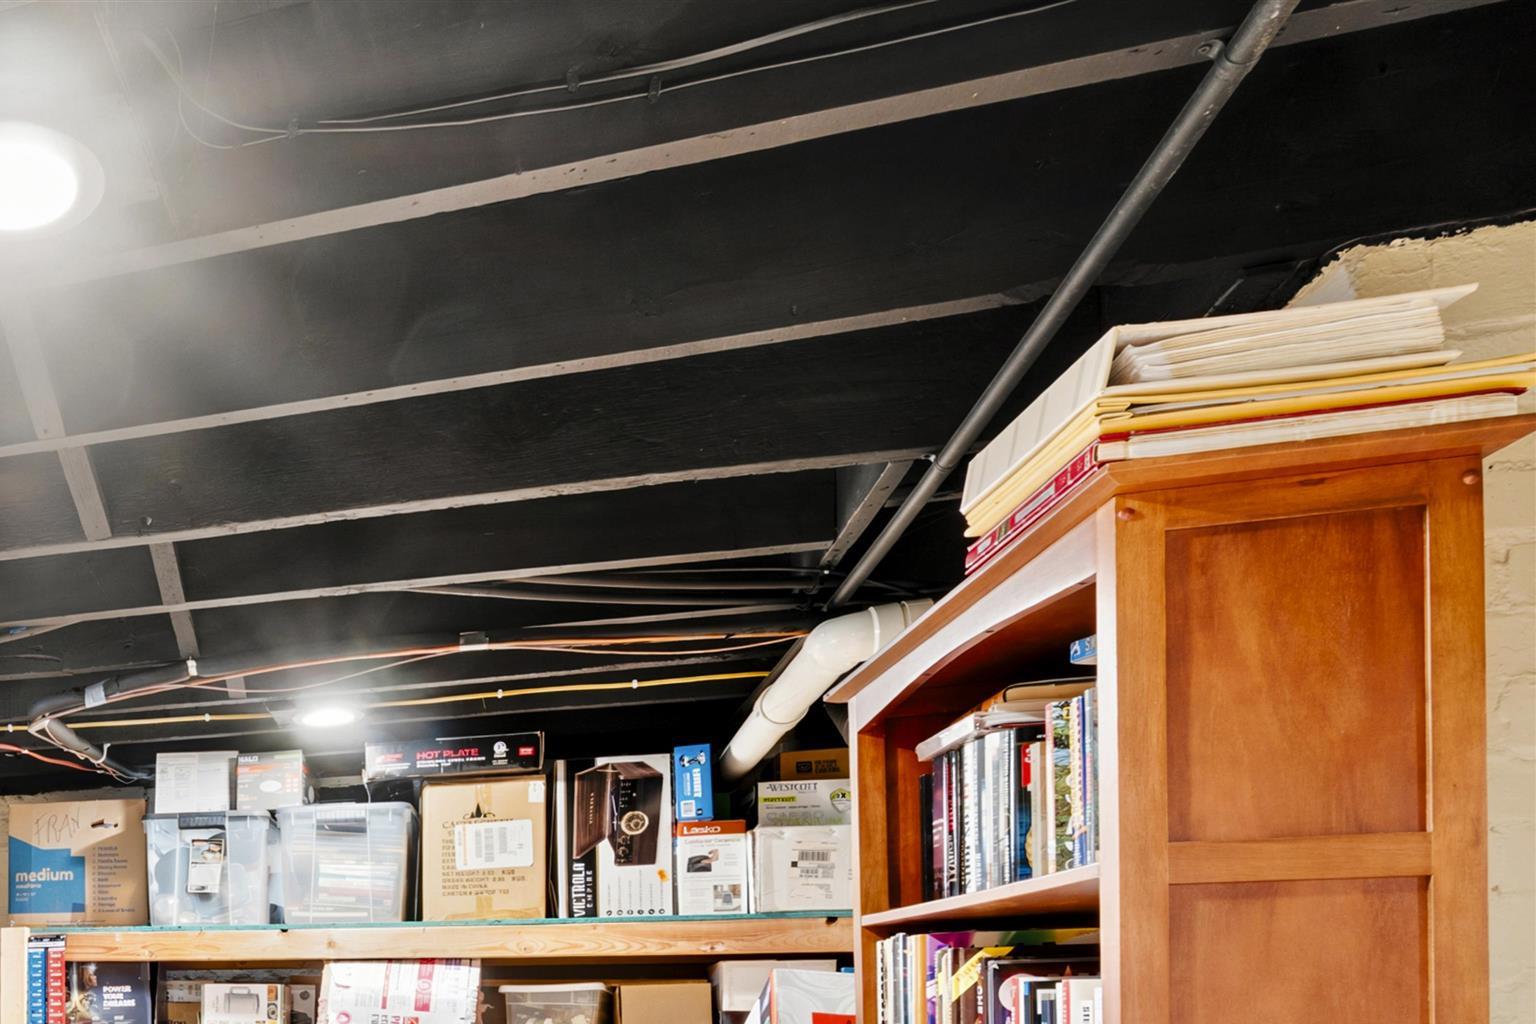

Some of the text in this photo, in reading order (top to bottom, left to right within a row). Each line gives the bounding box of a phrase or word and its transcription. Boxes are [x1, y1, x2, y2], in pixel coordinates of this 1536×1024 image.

[416, 748, 479, 760] HOT PLATE
[768, 783, 818, 792] WESTCOTT
[15, 868, 74, 882] medium
[572, 862, 586, 918] VICTROLA
